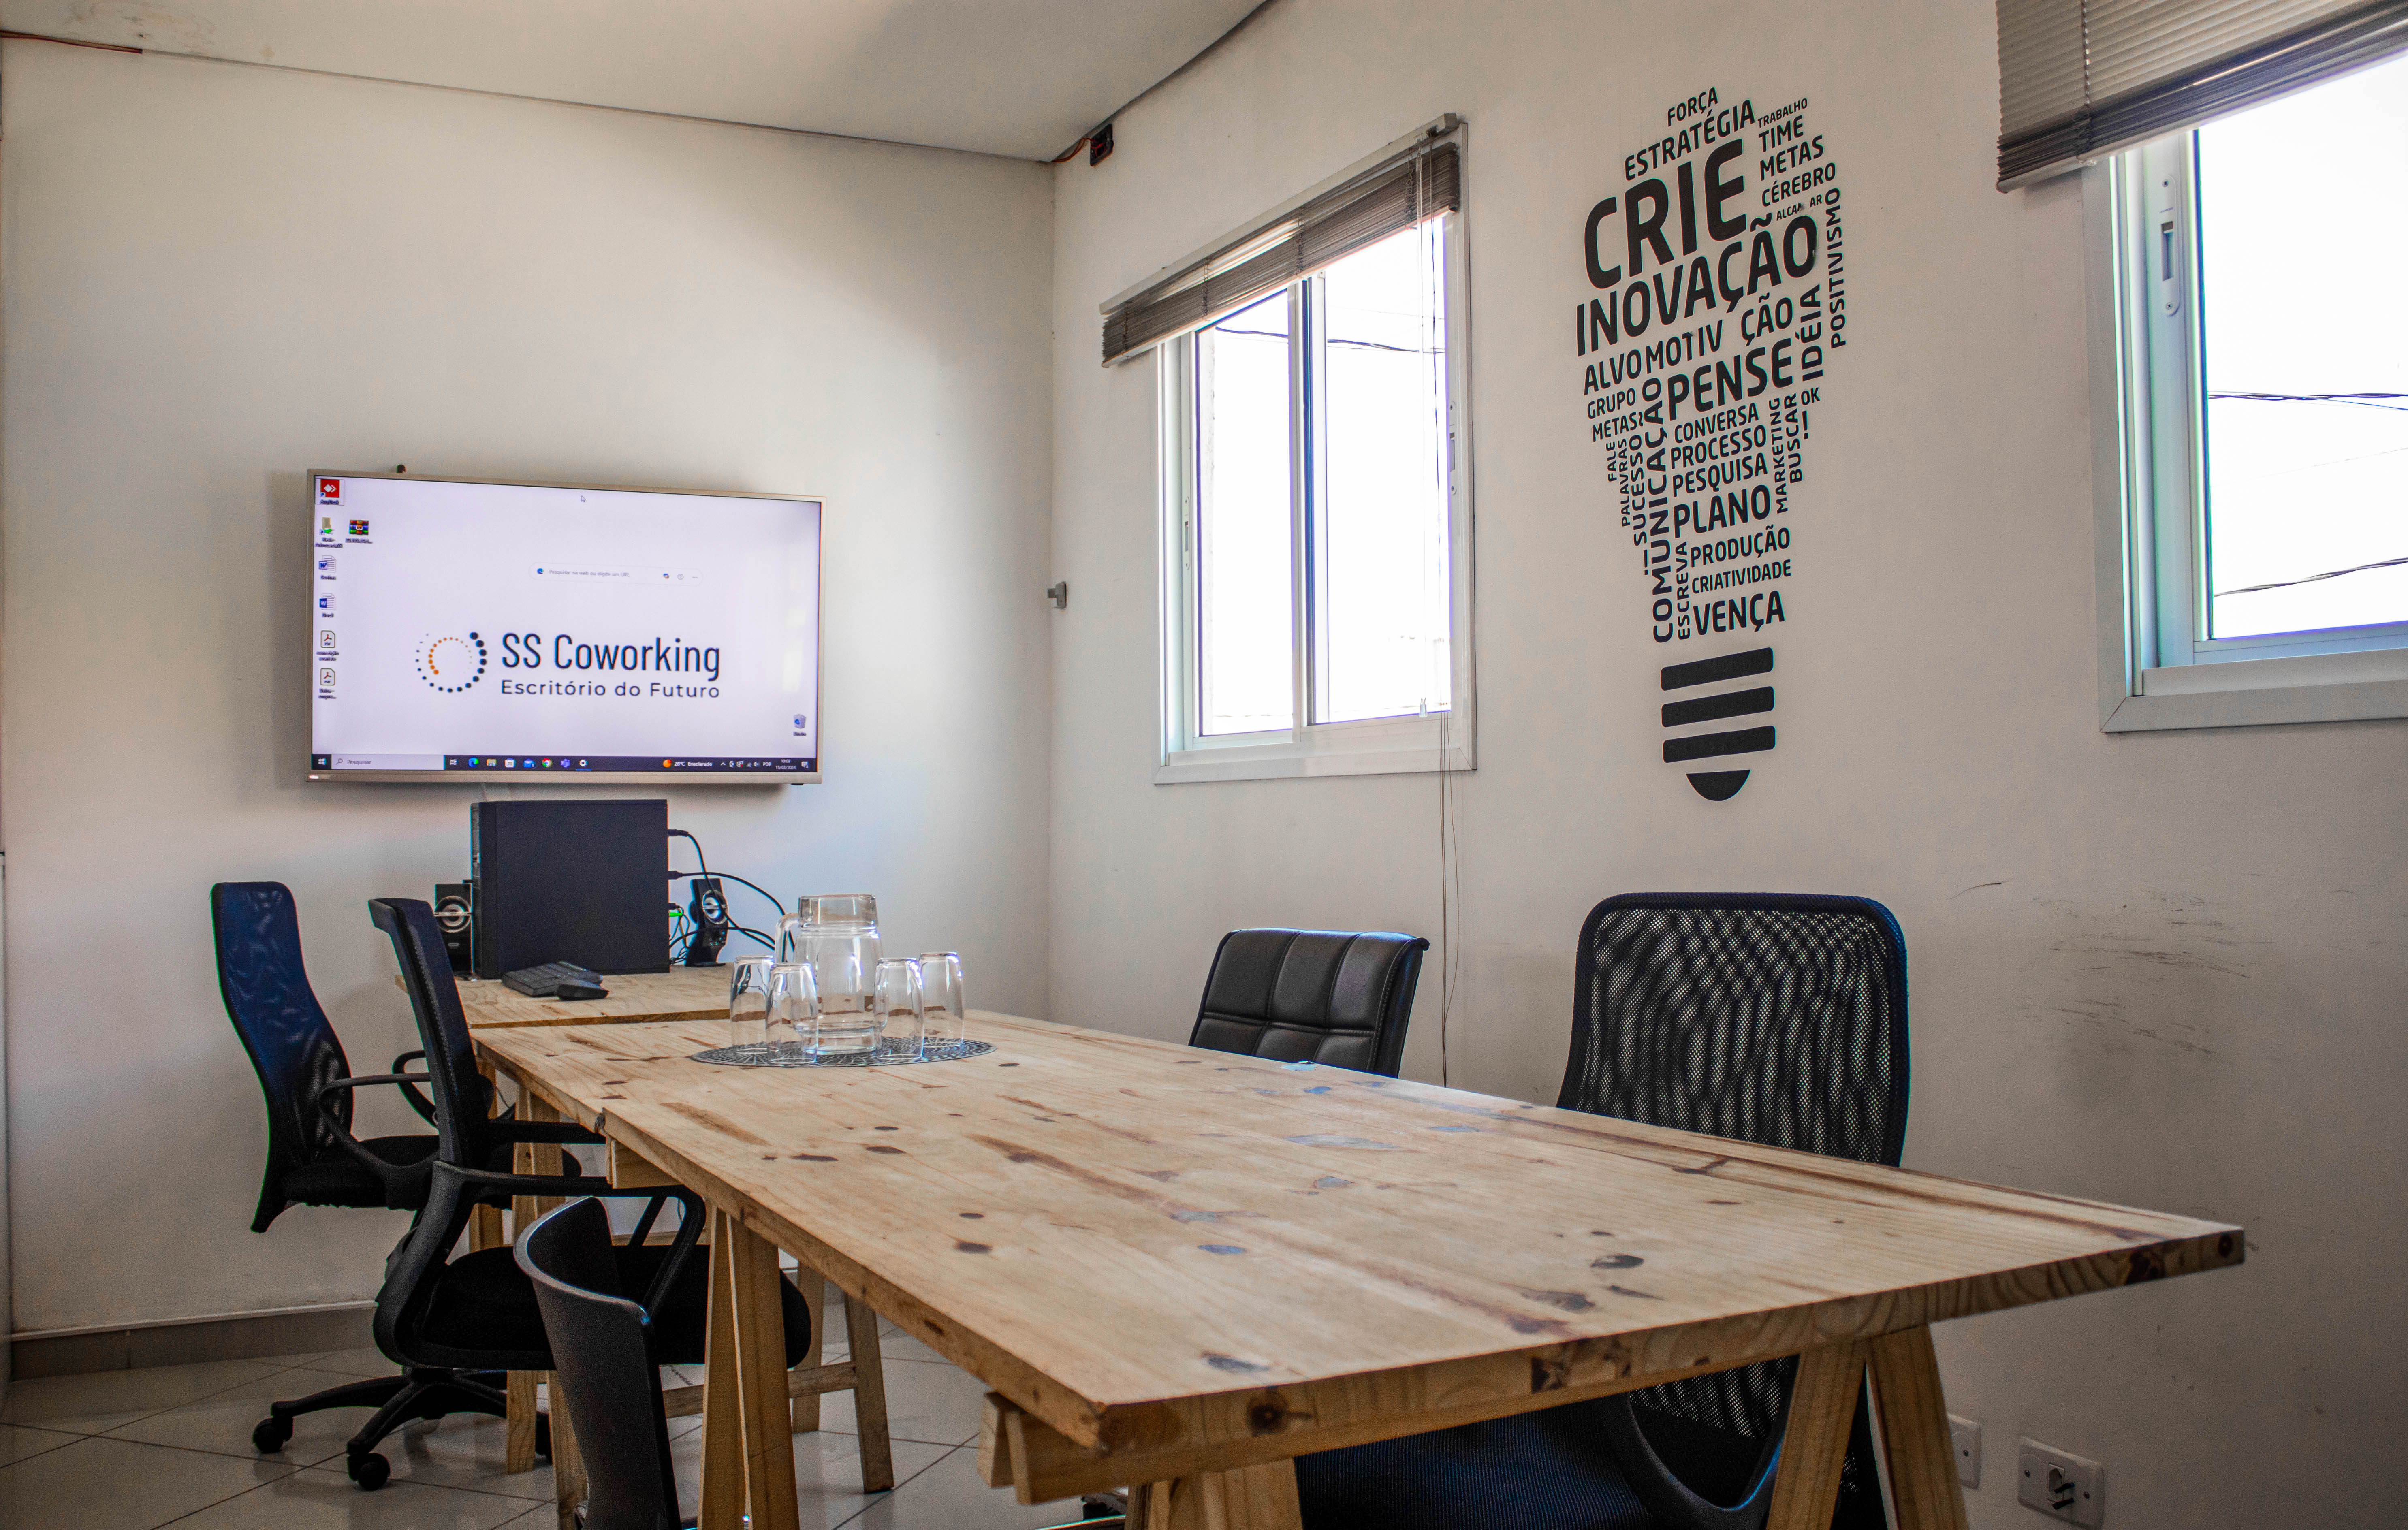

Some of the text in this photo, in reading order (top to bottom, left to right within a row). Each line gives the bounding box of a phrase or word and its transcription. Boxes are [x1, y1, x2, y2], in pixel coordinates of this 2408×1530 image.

[1668, 87, 1718, 127] FORÇA
[1758, 98, 1808, 128] TRABALHO
[1625, 100, 1755, 181] ESTRATÉGIA
[1759, 115, 1804, 152] TIME
[1760, 135, 1824, 181] METAS
[1762, 162, 1836, 207] CÉREBRO
[1584, 139, 1747, 289] CRIE
[1577, 213, 1817, 356] INOVAÇÃO
[1825, 188, 1846, 348] POSITIVISMO
[1795, 284, 1823, 381] IDÉIA
[1584, 349, 1641, 396] ALVO
[1667, 337, 1793, 421] PENSE
[1587, 388, 1635, 419] GRUPO
[1801, 387, 1820, 406] OK
[1675, 403, 1759, 444] CONVERSA
[1785, 393, 1802, 483] BUSCAR
[1606, 441, 1617, 482] FALE
[1671, 425, 1767, 469] PROCESSO
[1769, 398, 1788, 514] MARKETING
[1618, 438, 1630, 527] PALAVRAS
[1629, 434, 1647, 546] SUCESSO
[1673, 452, 1768, 497] PESQUISA
[1674, 485, 1771, 538] PLANO
[1691, 525, 1790, 567] PRODUÇÃO
[1676, 541, 1690, 640] ESCREVA
[1692, 559, 1791, 594] CRIATIVIDADE
[1693, 591, 1785, 636] VENÇA
[502, 632, 719, 681] SS Coworking
[501, 679, 719, 698] Escritório do Futuro
